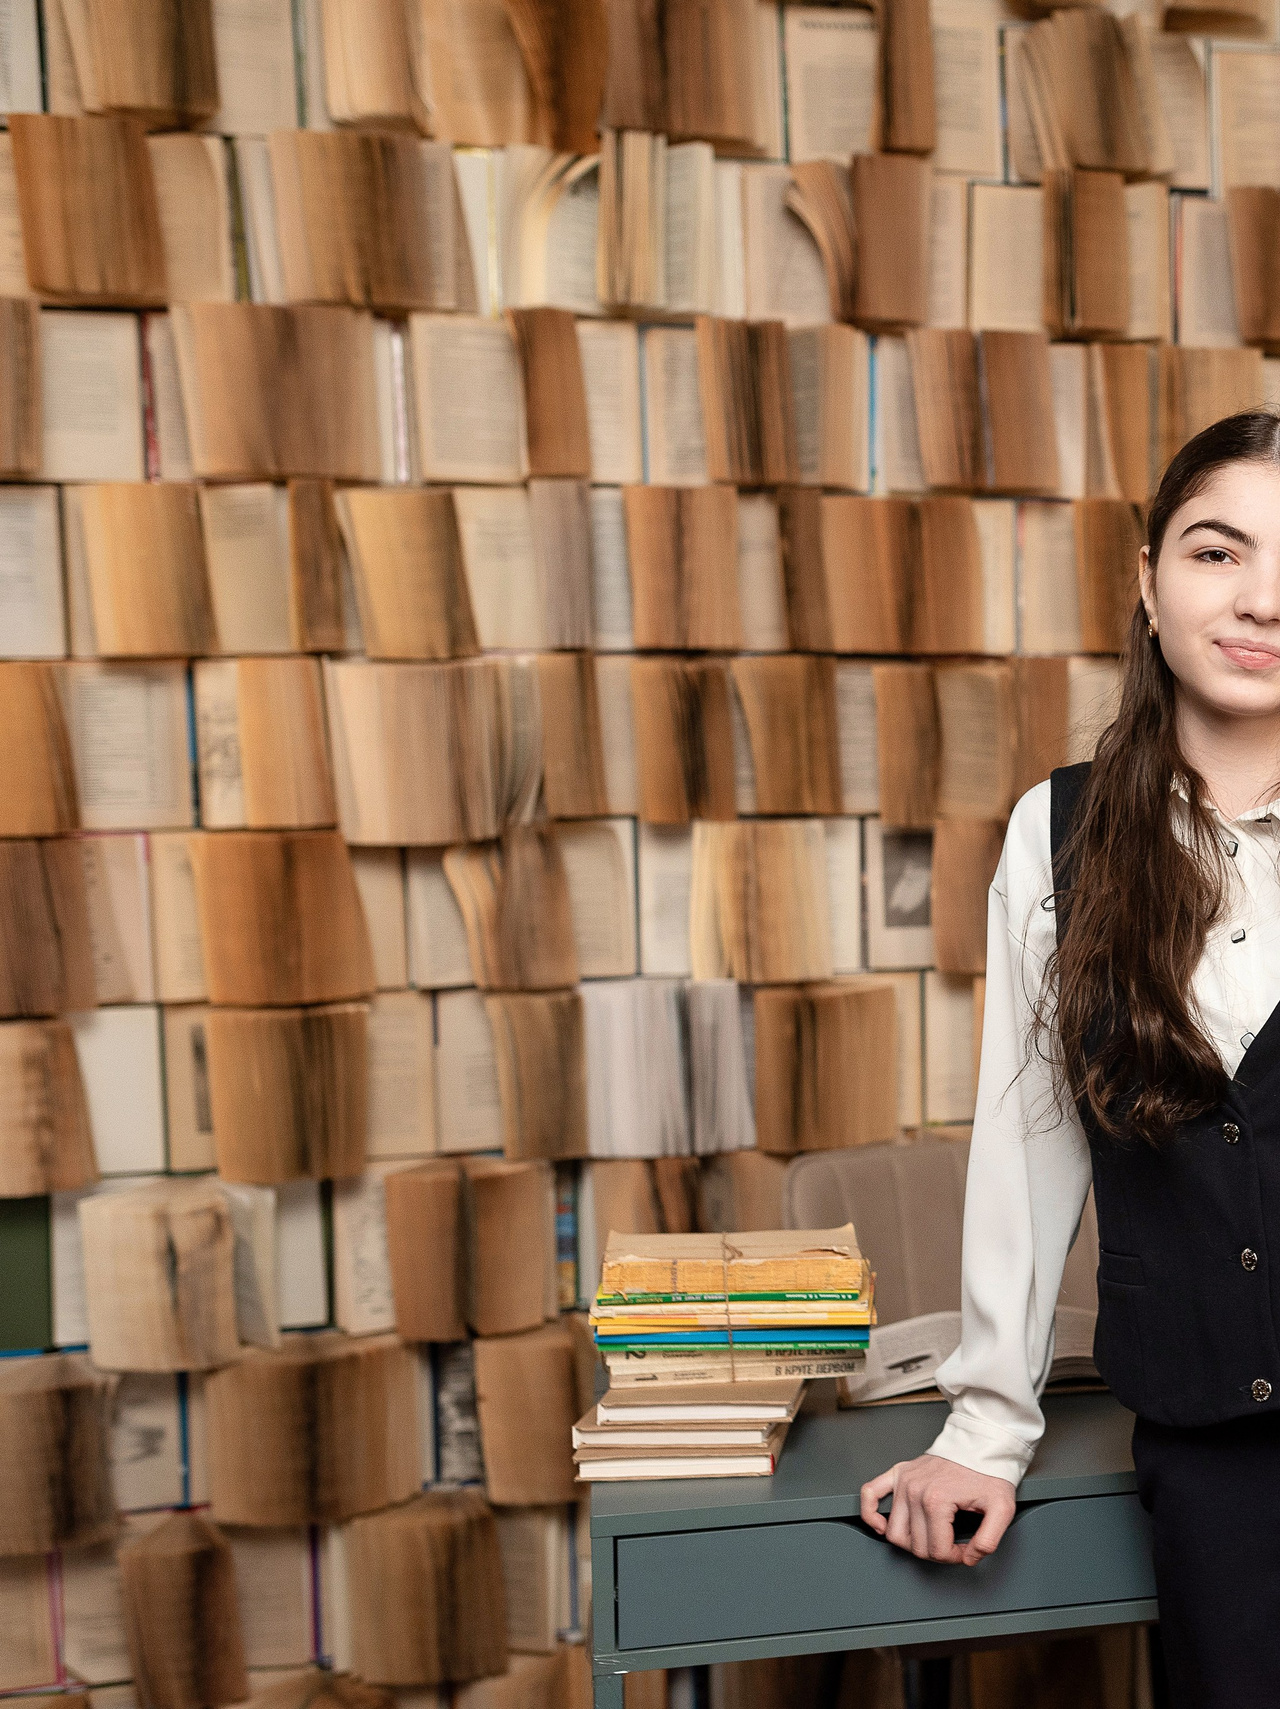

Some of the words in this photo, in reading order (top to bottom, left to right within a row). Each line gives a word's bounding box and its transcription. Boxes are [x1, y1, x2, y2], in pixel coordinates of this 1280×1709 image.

[775, 1366, 782, 1375] В
[785, 1364, 812, 1375] КРУГЕ
[816, 1362, 855, 1374] ПЕРВОМ
